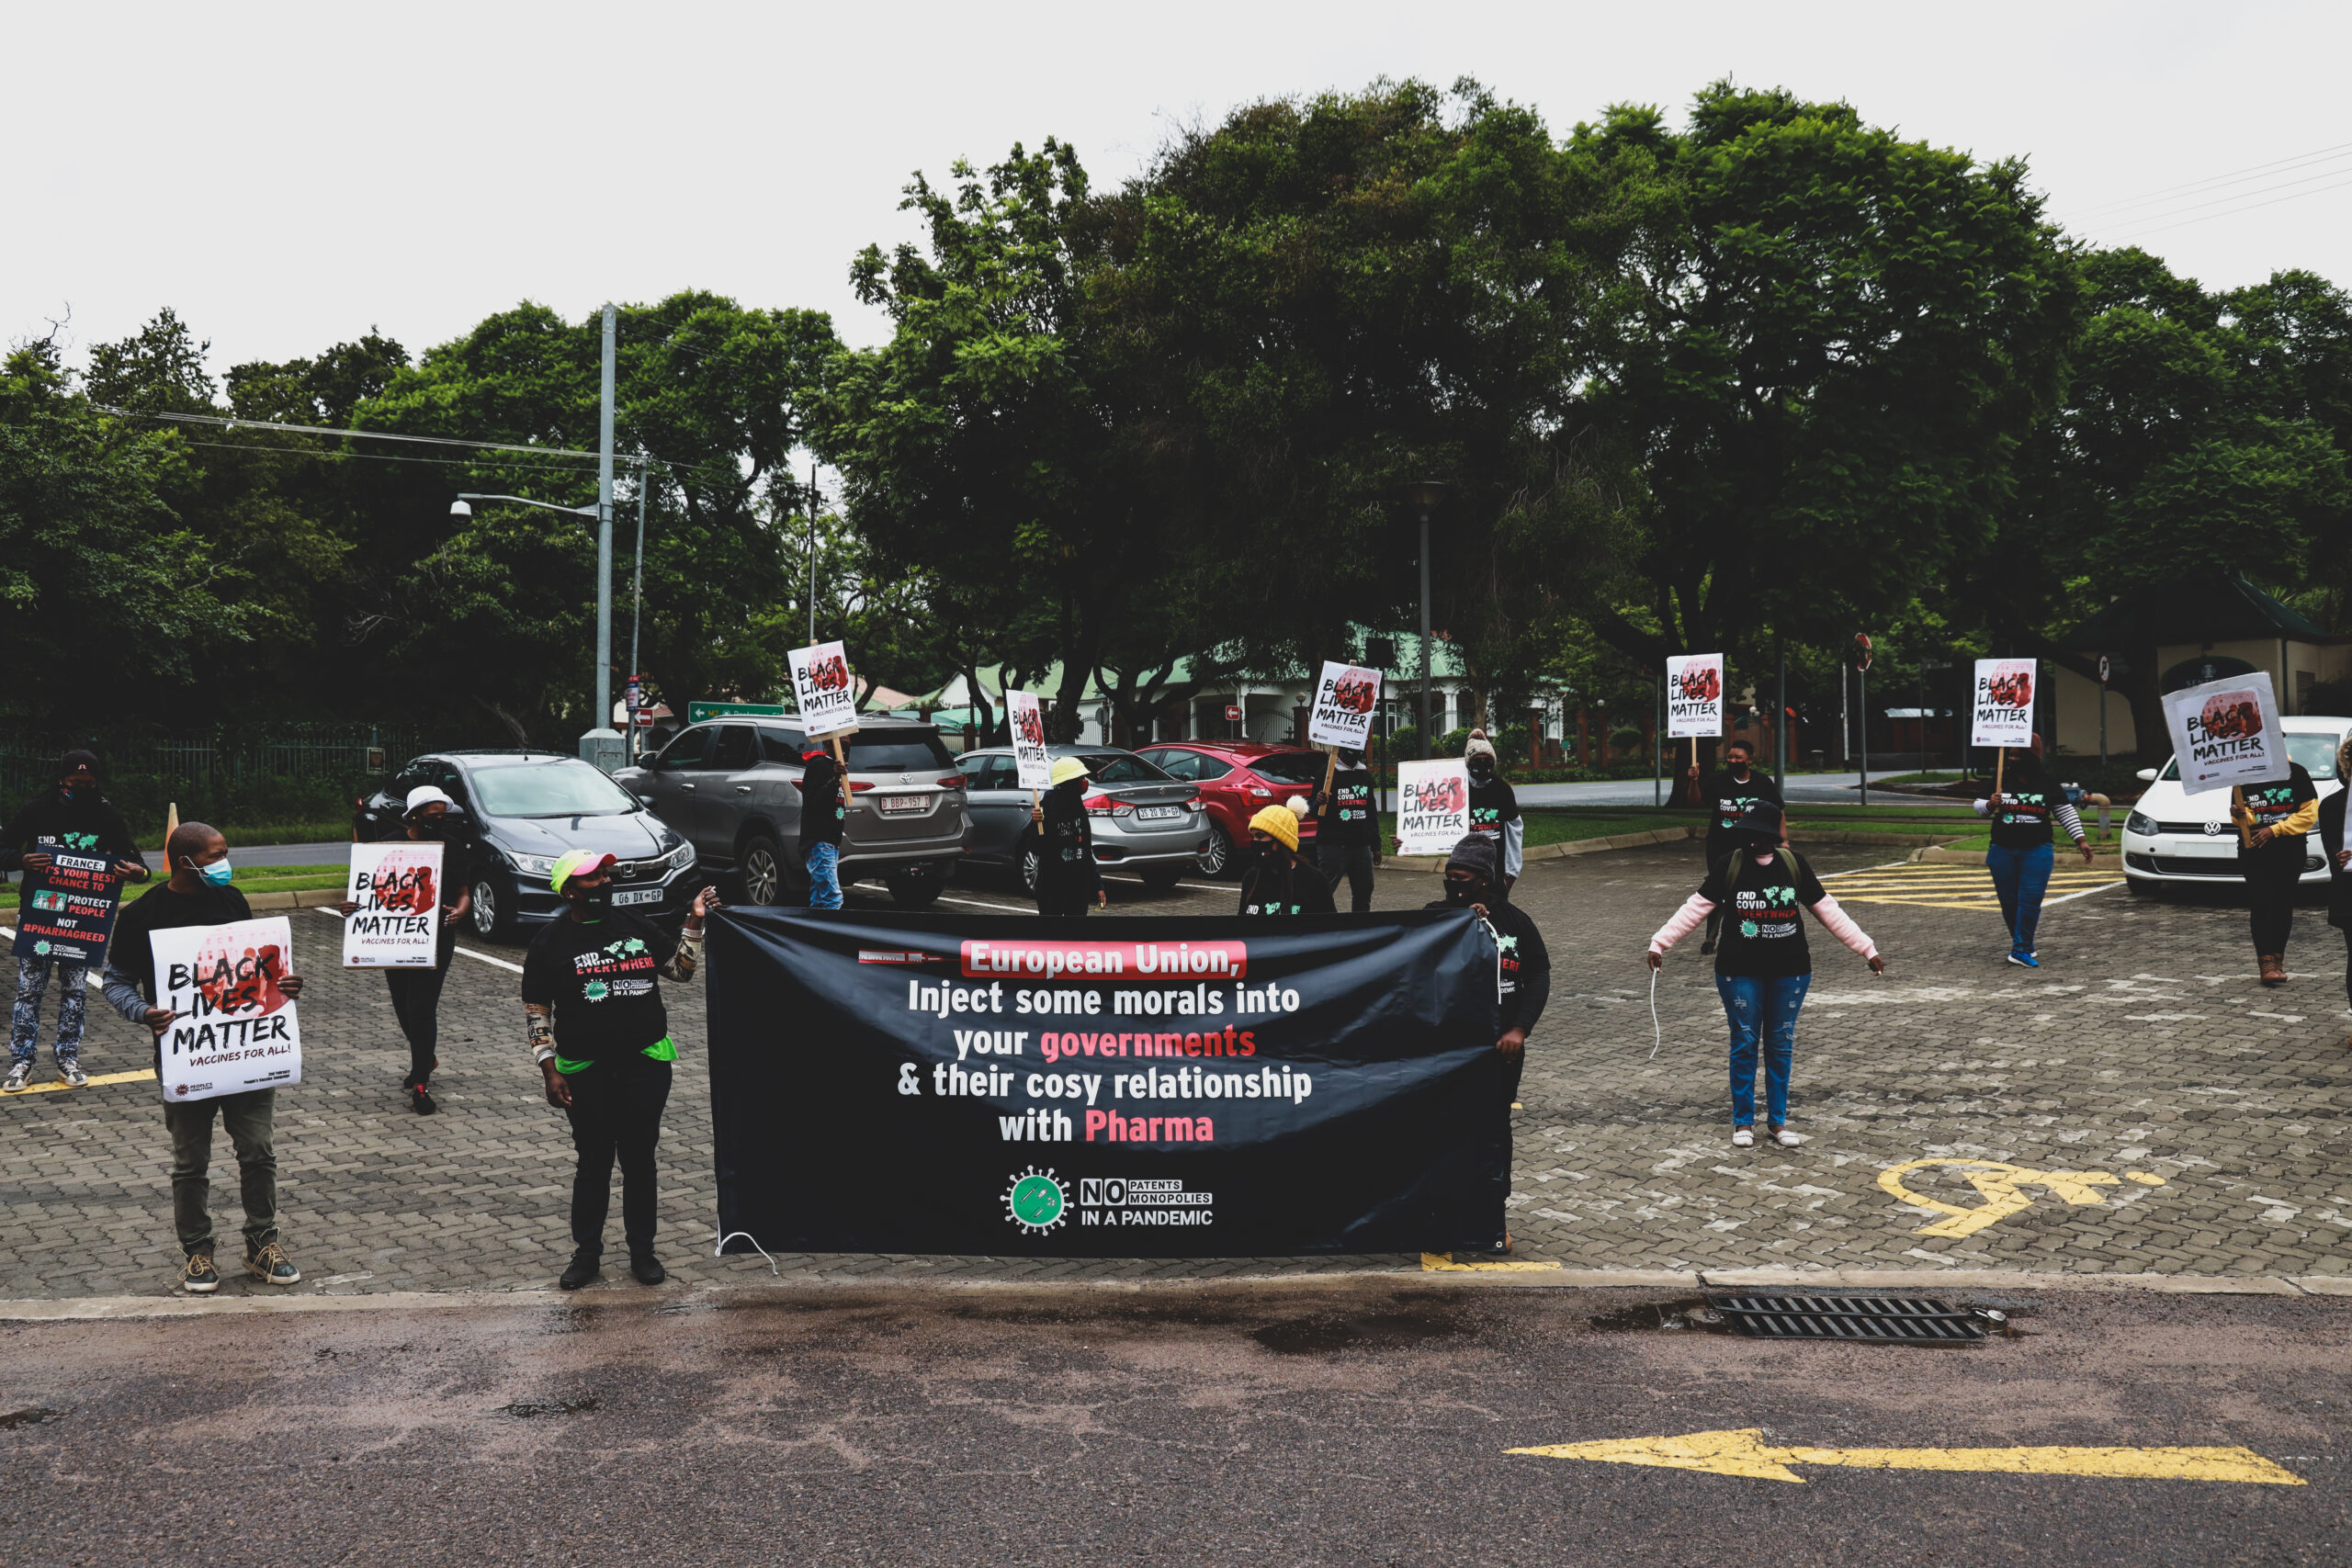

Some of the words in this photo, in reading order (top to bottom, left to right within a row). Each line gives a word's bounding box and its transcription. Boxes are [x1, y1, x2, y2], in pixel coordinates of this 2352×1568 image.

[797, 660, 841, 682] BLACK
[800, 676, 837, 695] LIVES
[1671, 672, 1713, 687] BLACK
[1979, 677, 2027, 691] BLACK
[1323, 679, 1370, 697] BLACK
[1671, 687, 1705, 701] LIVES
[804, 691, 851, 712] MATTER
[1320, 694, 1360, 710] LIVES
[1978, 693, 2016, 705] LIVES
[1671, 703, 1717, 716] MATTER
[1977, 709, 2027, 723] MATTER
[1012, 710, 1036, 727] BLACK
[1316, 708, 1367, 728] MATTER
[2187, 706, 2251, 731] BLACK
[1015, 728, 1036, 744] LIVES
[2190, 724, 2242, 746] LIVES
[1018, 746, 1046, 763] MATTER
[2194, 737, 2264, 761] MATTER
[2203, 757, 2234, 766] VACCINES
[1403, 782, 1459, 797] BLACK
[1403, 798, 1448, 813] LIVES
[2250, 800, 2267, 808] OVID
[1403, 814, 1463, 830] MATTER
[39, 836, 55, 844] END
[61, 856, 103, 871] FRANCE:
[49, 876, 89, 889] CHANCE
[92, 883, 105, 891] TO
[63, 868, 90, 880] YOUR
[92, 873, 116, 884] BEST
[356, 873, 427, 893] BLACK
[68, 895, 112, 909] PROTECT
[356, 894, 413, 912] LIVES
[633, 891, 643, 902] DX
[651, 890, 662, 900] GP
[1736, 891, 1757, 900] END
[68, 906, 107, 918] PEOPLE
[1736, 900, 1767, 909] COVID
[57, 918, 77, 928] NOT
[353, 916, 430, 935] MATTER
[23, 923, 106, 942] #PHARMAGREED
[397, 938, 411, 946] FOR
[970, 942, 1123, 979] European
[1136, 943, 1239, 977] Union,
[168, 953, 275, 990] BLACK
[613, 979, 630, 990] NO
[171, 987, 257, 1020] LIVES
[909, 980, 1003, 1020] Inject
[1015, 989, 1102, 1014] some
[1114, 983, 1224, 1015] morals
[1237, 982, 1299, 1013] into
[173, 1015, 290, 1055] MATTER
[954, 1029, 1029, 1060] your
[1040, 1024, 1256, 1064] governments
[189, 1051, 241, 1066] VACCINES
[244, 1048, 265, 1060] FOR
[267, 1043, 290, 1056] ALL!
[897, 1062, 921, 1096] &
[933, 1064, 1014, 1098] their
[1025, 1071, 1102, 1106] cosy
[1114, 1066, 1312, 1104] relationship
[999, 1108, 1071, 1142] with
[1086, 1110, 1213, 1142] Pharma
[1082, 1179, 1126, 1204] NO
[1130, 1181, 1181, 1190] PATENTS
[1130, 1194, 1211, 1203] MONOPOLIES
[1081, 1211, 1099, 1225] IN
[1104, 1211, 1117, 1225] A
[1122, 1211, 1213, 1225] PANDEMIC
